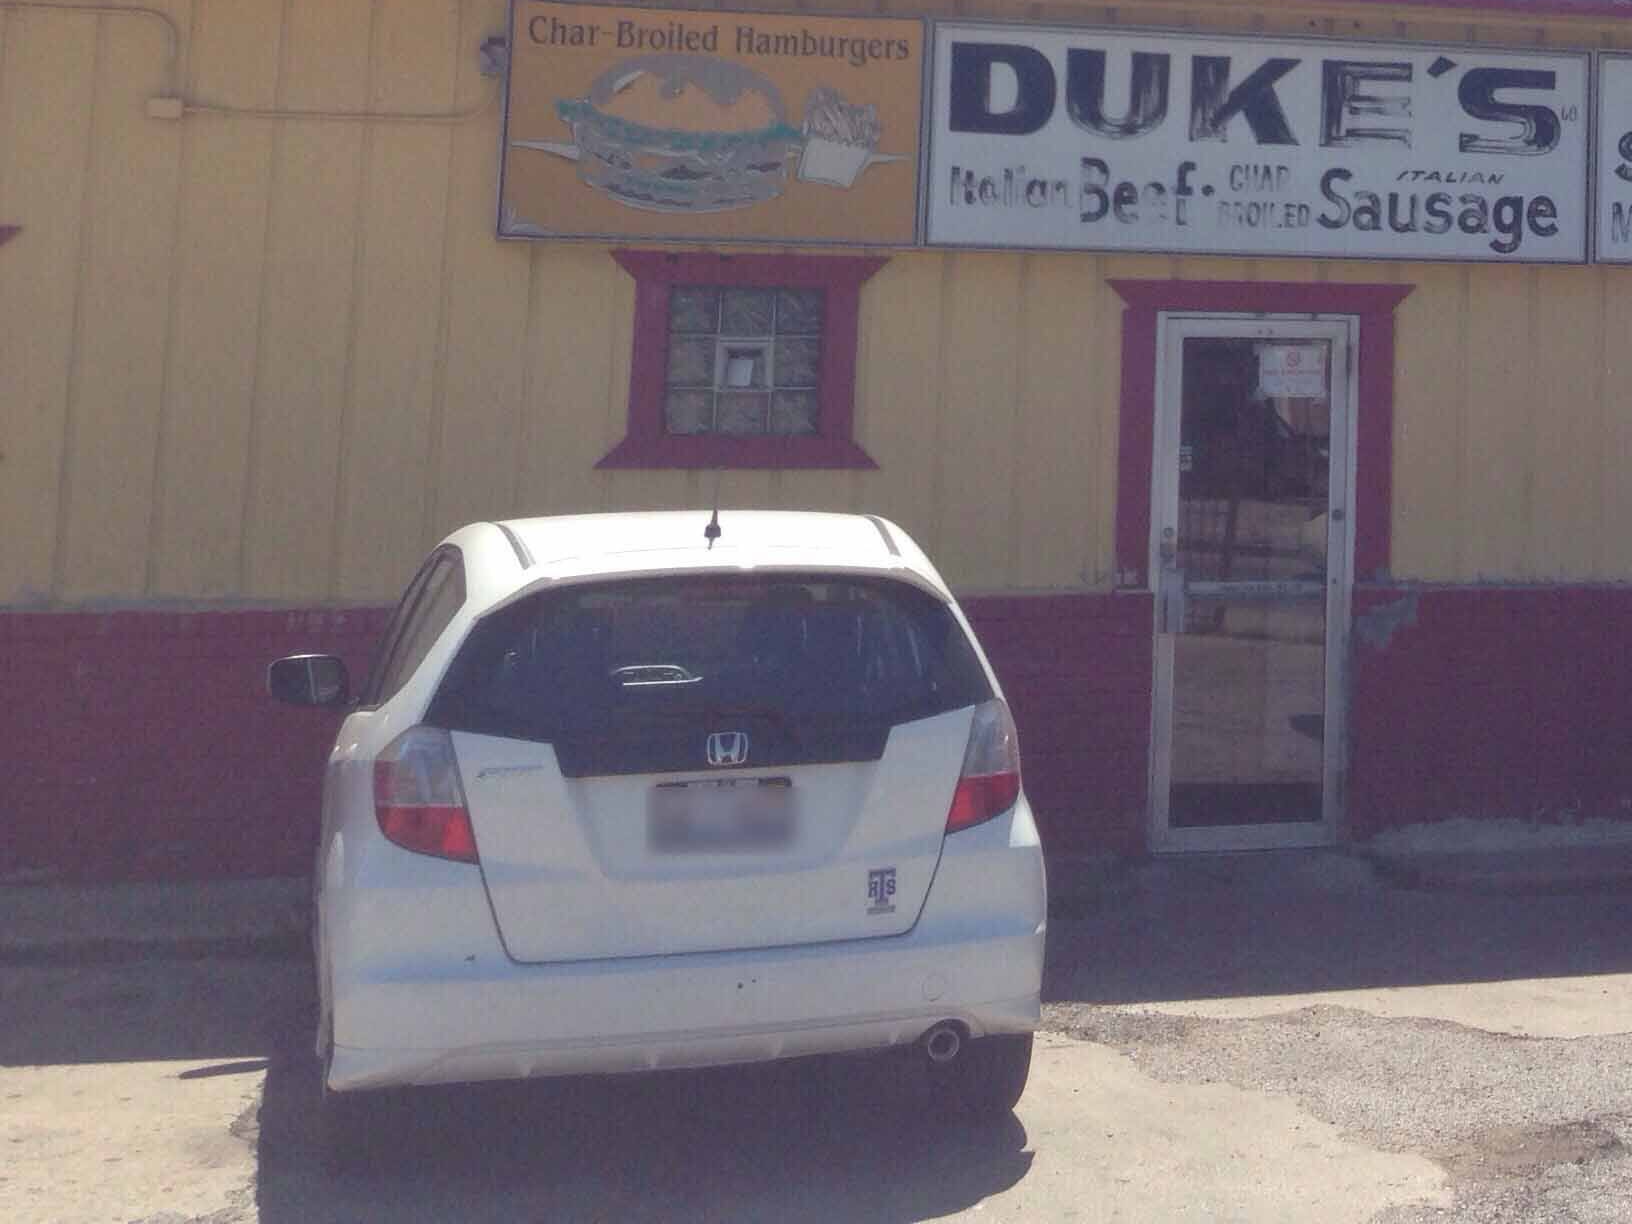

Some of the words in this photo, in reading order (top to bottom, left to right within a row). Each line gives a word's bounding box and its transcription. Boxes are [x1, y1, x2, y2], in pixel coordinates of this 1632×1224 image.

[735, 25, 911, 66] Hamburgers
[948, 40, 1563, 158] DUKE'S
[1395, 169, 1505, 186] ITALIAN
[1316, 167, 1560, 255] Sausage
